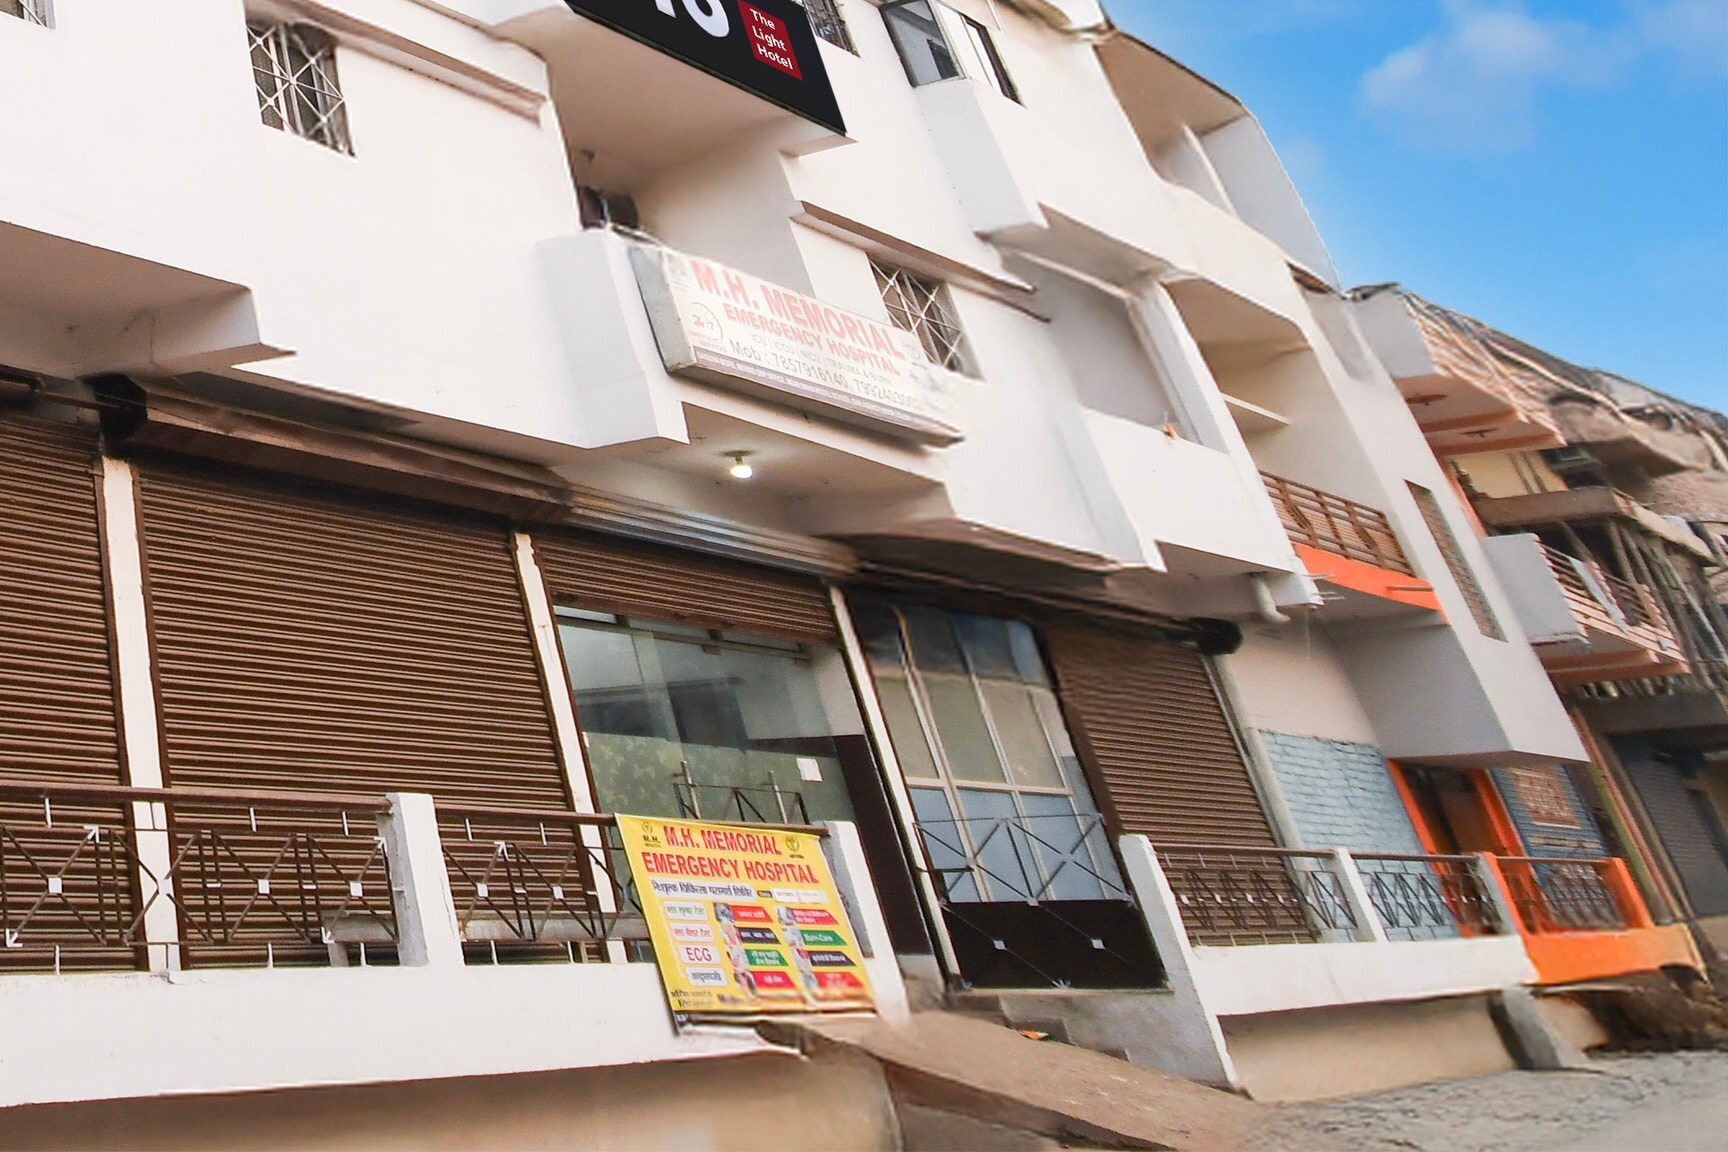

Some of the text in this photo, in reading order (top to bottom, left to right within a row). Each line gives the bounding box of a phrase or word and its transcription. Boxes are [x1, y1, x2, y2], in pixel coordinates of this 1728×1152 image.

[750, 8, 775, 30] The
[752, 25, 787, 51] Light
[756, 43, 793, 70] Hotel
[690, 259, 760, 311] M.H.
[760, 285, 906, 360] MEMORIAL
[723, 302, 901, 376] EMERGENCY HOSPITAL
[663, 825, 782, 856] M.H. MEMORIAL
[641, 851, 819, 885] EMERGENCY HOSPITAL
[686, 946, 712, 962] ECG
